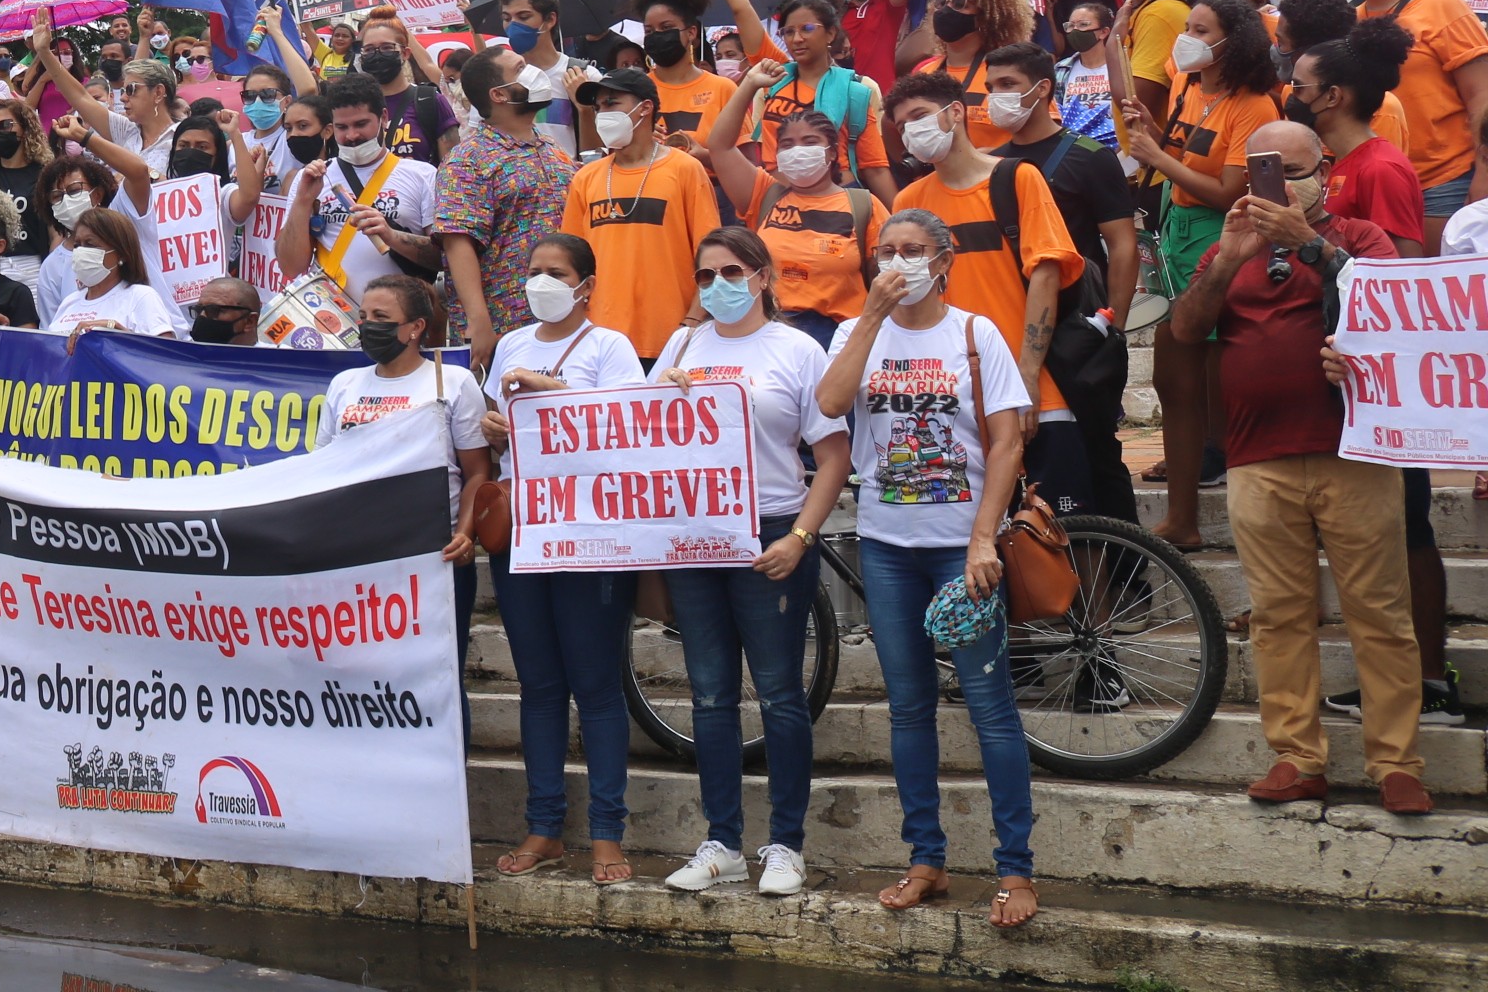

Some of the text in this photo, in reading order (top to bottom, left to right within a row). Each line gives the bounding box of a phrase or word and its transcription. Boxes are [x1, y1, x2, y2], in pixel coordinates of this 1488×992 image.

[1346, 273, 1488, 332] ESTAM
[267, 319, 290, 341] RUA
[870, 370, 958, 383] CAMPANHA
[882, 358, 943, 371] SINDSERM
[868, 381, 958, 397] SALARIAL
[1342, 352, 1400, 408] EM
[70, 381, 115, 440] LEI
[122, 383, 192, 444] DOS
[358, 396, 409, 405] SINDSERM
[867, 393, 959, 415] 2022
[535, 396, 720, 456] ESTAMOS
[526, 466, 744, 526] EM GREVE!
[11, 502, 120, 554] Pessoa
[122, 517, 229, 570] (MDB)
[543, 538, 615, 558] SINDSERM
[22, 573, 160, 638] Teresina
[166, 590, 250, 659] exige
[255, 574, 421, 662] respeito!
[37, 662, 187, 732] obrigação
[196, 685, 213, 723] e
[223, 685, 314, 728] nosso
[320, 679, 434, 730] direito.
[58, 784, 178, 814] PRA LUTA CONTINUAR!
[209, 792, 256, 816] Travessia
[210, 817, 233, 825] COLETIVO
[234, 818, 257, 827] SINDICAL
[262, 820, 286, 829] POPULAR
